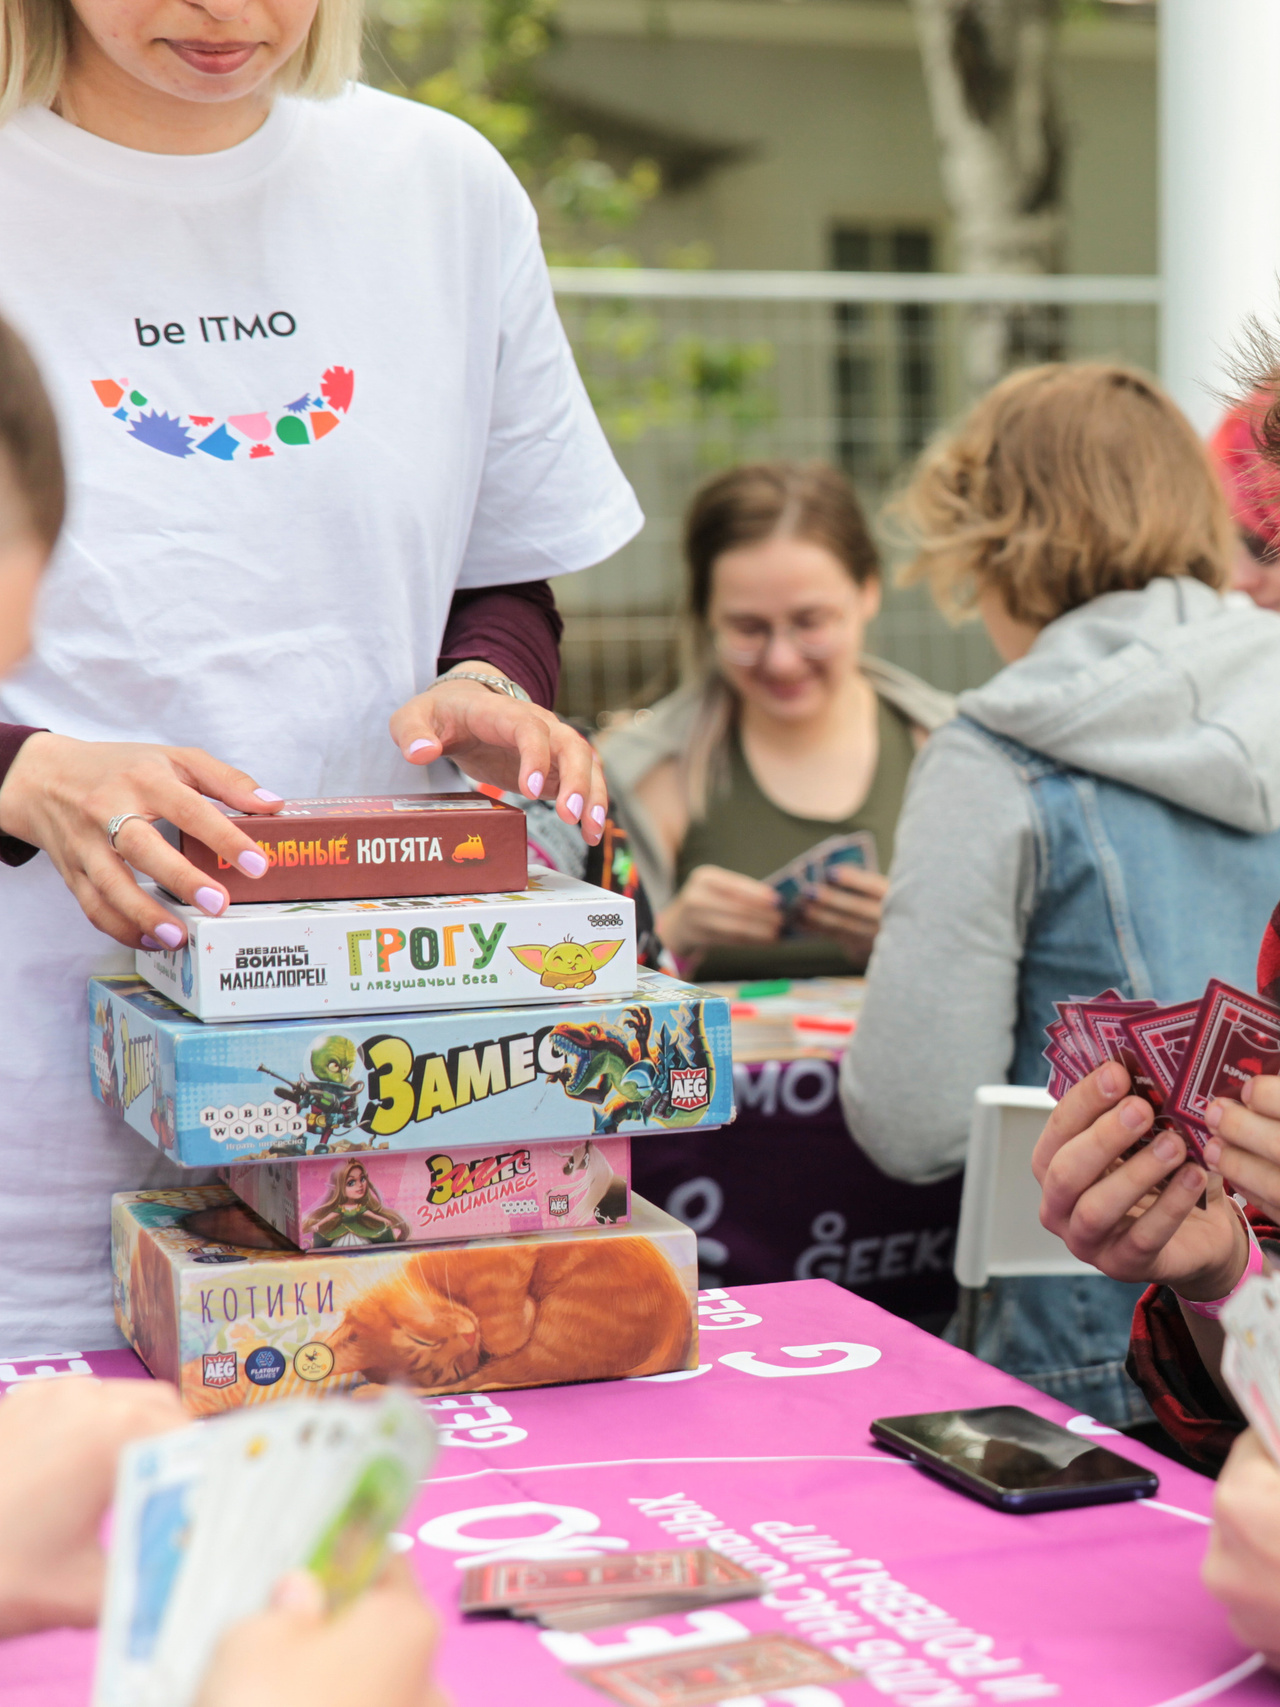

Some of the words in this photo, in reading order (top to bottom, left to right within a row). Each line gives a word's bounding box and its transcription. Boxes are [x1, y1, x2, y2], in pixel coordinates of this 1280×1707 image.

[134, 317, 186, 347] be
[198, 311, 297, 342] ITMO
[217, 833, 350, 870] ЫВНЫЕ
[356, 836, 443, 865] КОТЯТА
[346, 921, 508, 976] ГРОГУ
[219, 967, 328, 991] МАНДАЛОРЕЦ
[366, 977, 456, 992] лягушачьи
[462, 973, 498, 985] бега
[357, 1025, 567, 1137] ЗАМЕС
[671, 1077, 708, 1099] AEG
[204, 1104, 293, 1122] HOBBY
[213, 1120, 303, 1137] WORLD
[426, 1149, 531, 1206] ЗАМЕС
[550, 1200, 568, 1212] AEG
[200, 1279, 334, 1324] КОТИКИ
[204, 1361, 236, 1379] AEG
[250, 1366, 281, 1375] FLATOUT
